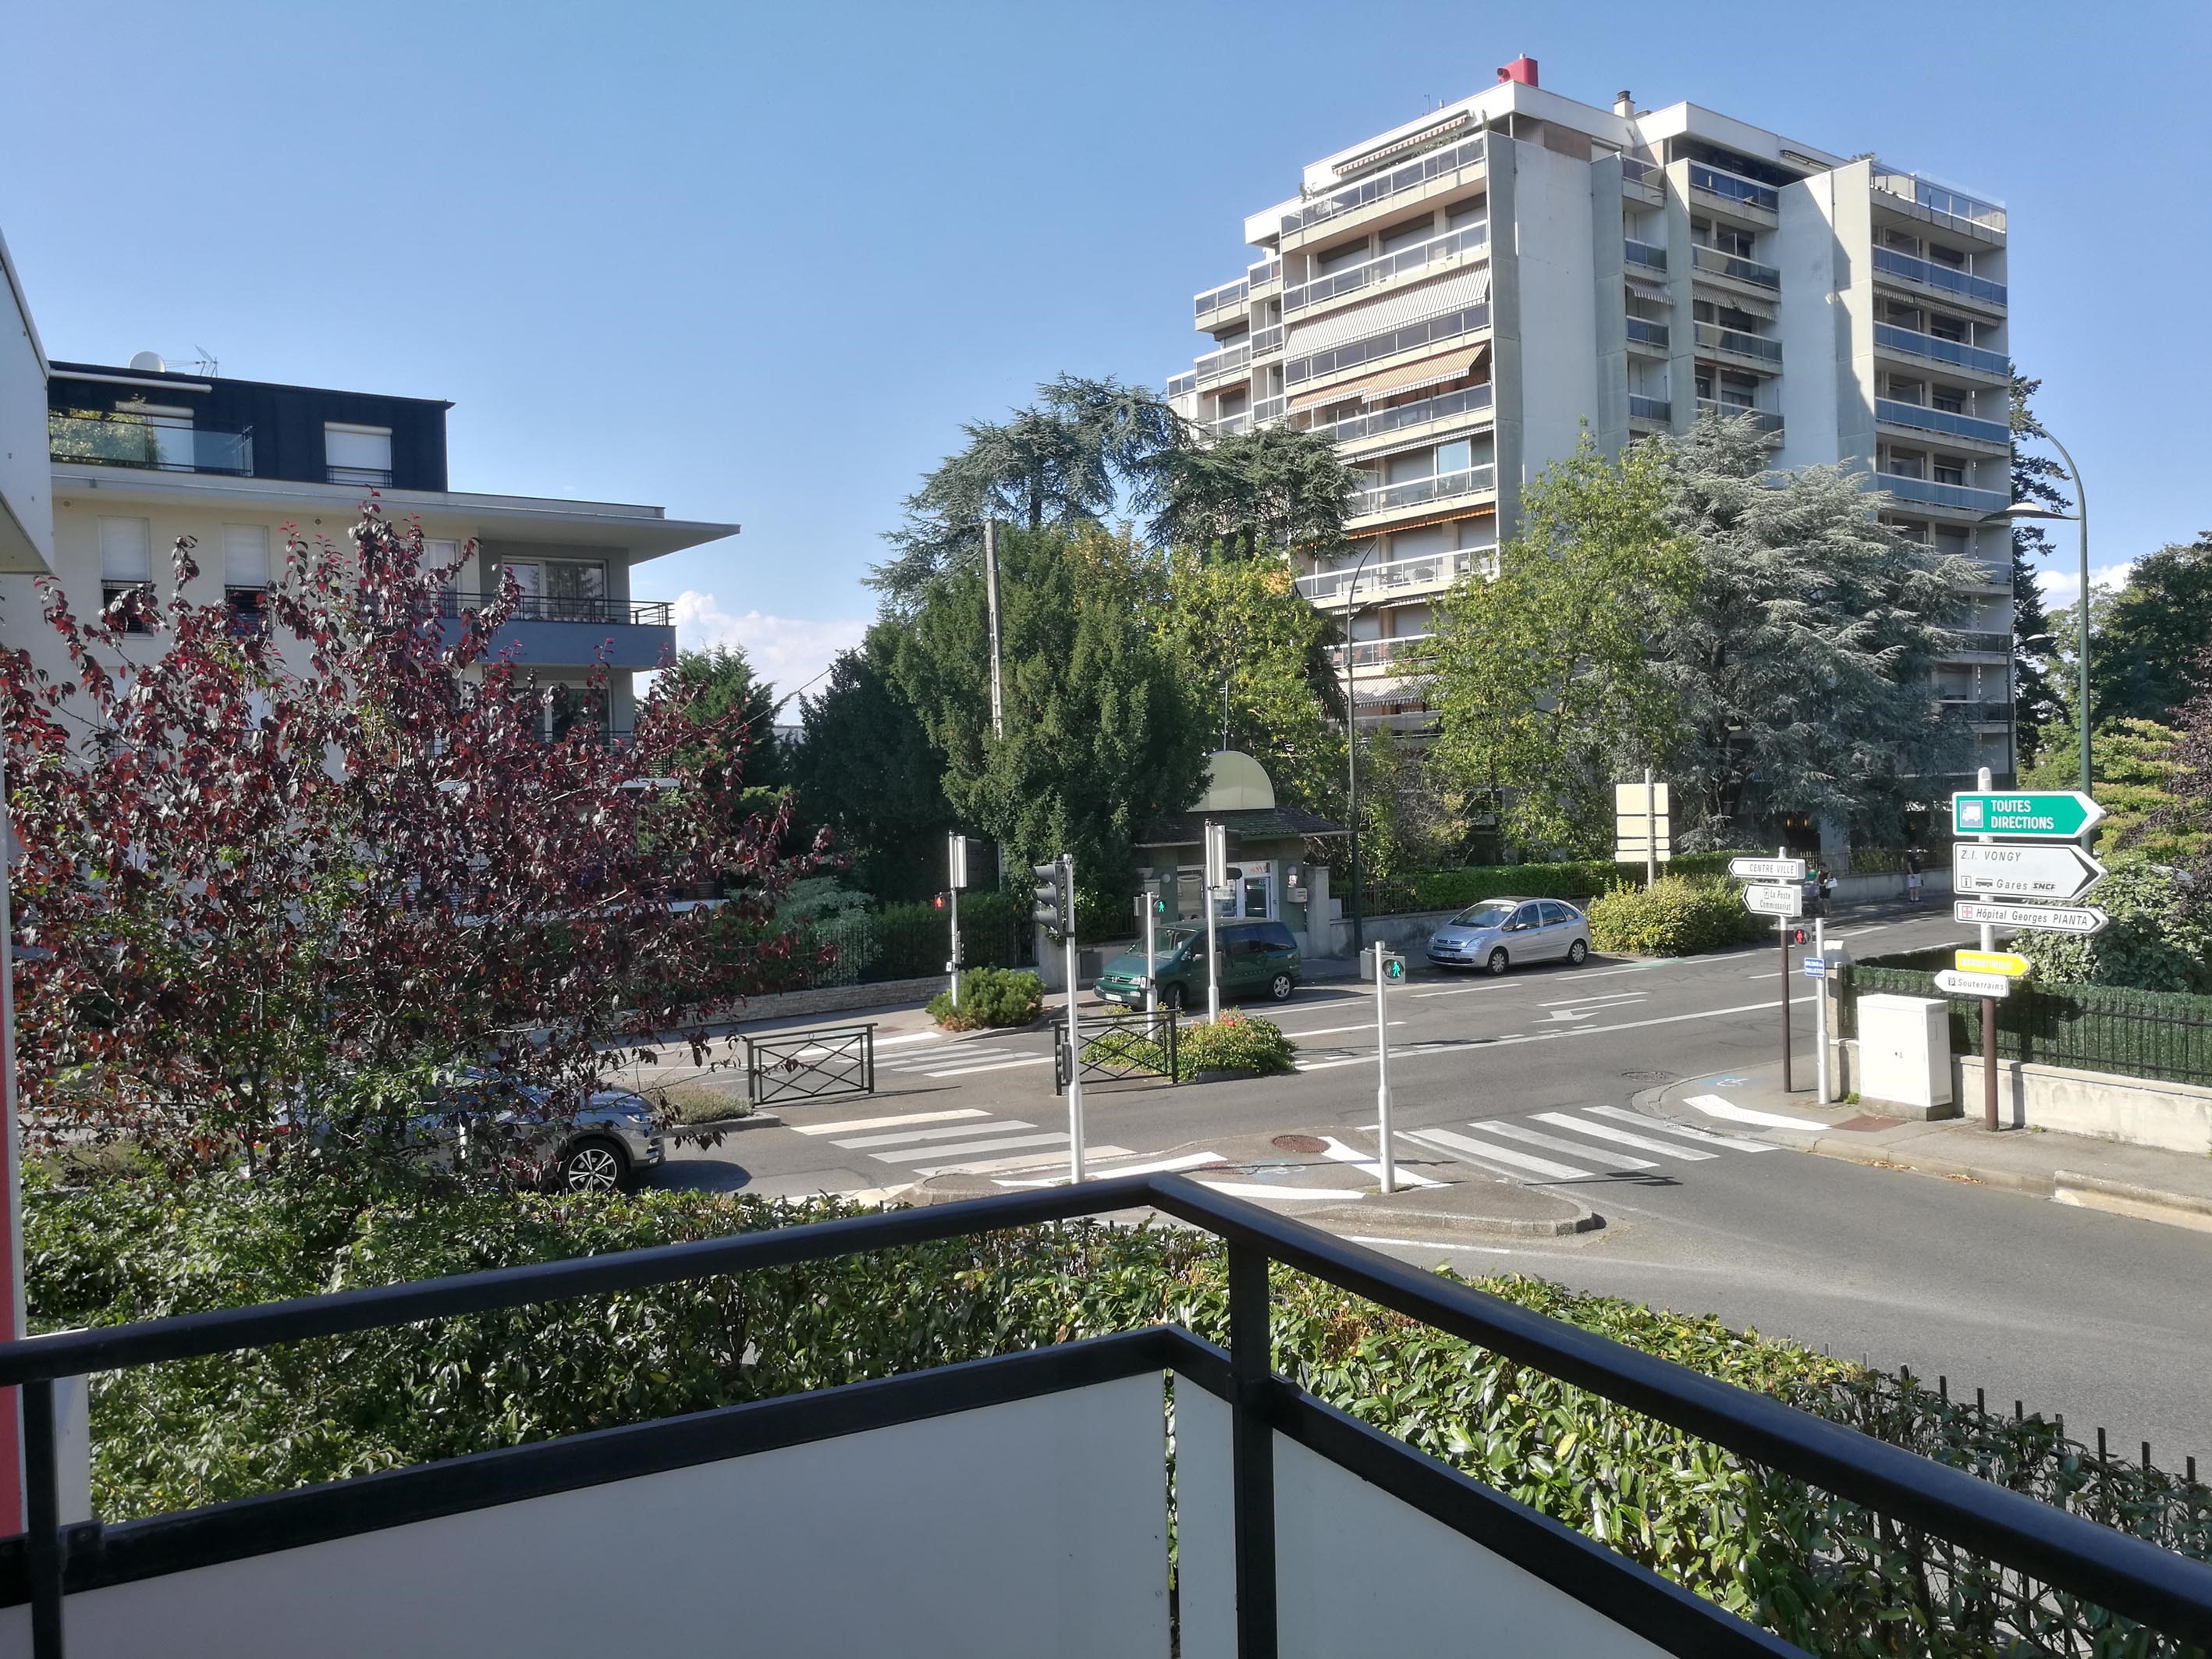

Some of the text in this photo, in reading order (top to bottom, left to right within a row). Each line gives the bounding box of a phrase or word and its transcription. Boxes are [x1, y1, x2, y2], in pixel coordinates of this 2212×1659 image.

[1990, 800, 2031, 812] TOUTES
[1990, 816, 2054, 830] DIRECTIONS
[1961, 850, 2021, 861] Z.I. VONGY
[1749, 863, 1794, 874] CENTRE VILLE
[1996, 879, 2028, 890] Gares
[1777, 890, 1791, 900] Poste
[1759, 899, 1791, 911] Commissariat
[1976, 908, 2088, 925] Hôpital Georges PIANTA
[1958, 979, 2004, 990] Souterrains
